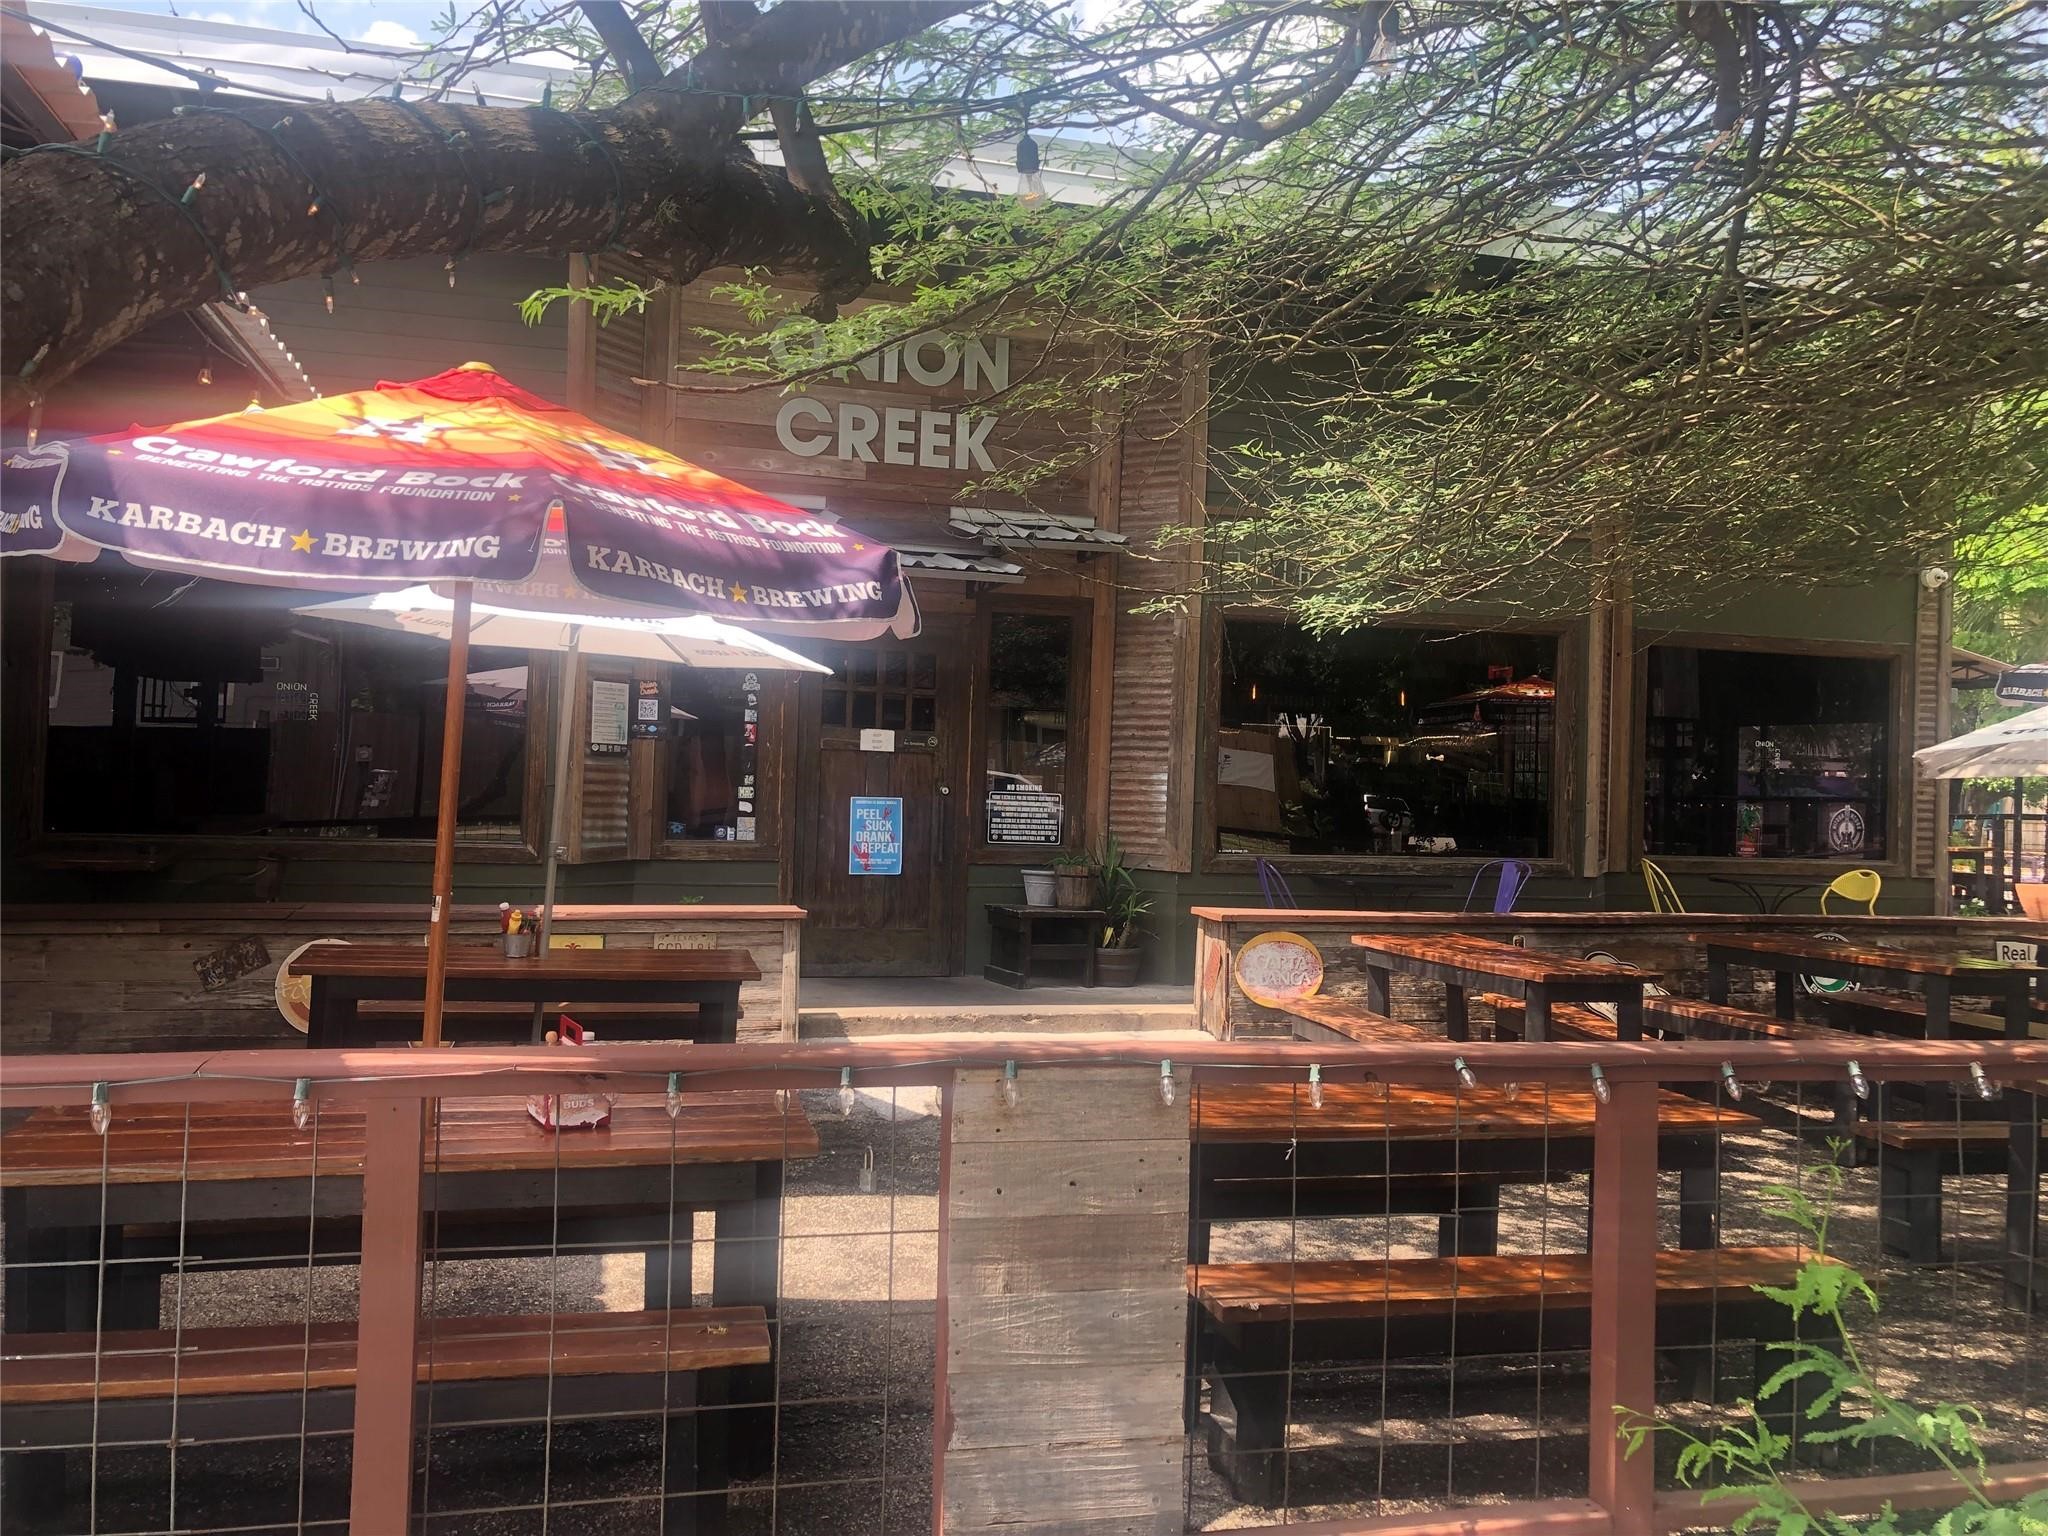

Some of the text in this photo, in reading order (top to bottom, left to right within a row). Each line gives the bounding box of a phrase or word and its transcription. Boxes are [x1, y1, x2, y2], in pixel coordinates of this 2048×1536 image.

[776, 397, 999, 471] CREEK
[132, 436, 528, 489] Crawford Bock
[135, 454, 496, 501] BENEFITING THE ASTROS FOUNDATION
[550, 473, 849, 537] Crawford Bock
[86, 496, 286, 548] KARBACH
[321, 531, 500, 560] BREWING
[673, 520, 704, 537] THE
[706, 528, 761, 548] ASTROS
[763, 538, 846, 554] FOUNDATION
[587, 544, 726, 600] KARBACH
[751, 581, 882, 608] BREWING
[276, 682, 307, 690] ONION
[309, 692, 319, 721] CREEK
[856, 808, 882, 819] PEEL
[866, 820, 892, 831] SUCK
[856, 831, 892, 842] DRANK
[861, 842, 900, 853] REPEAT
[2002, 945, 2031, 961] Real
[563, 1099, 595, 1110] BUDS
